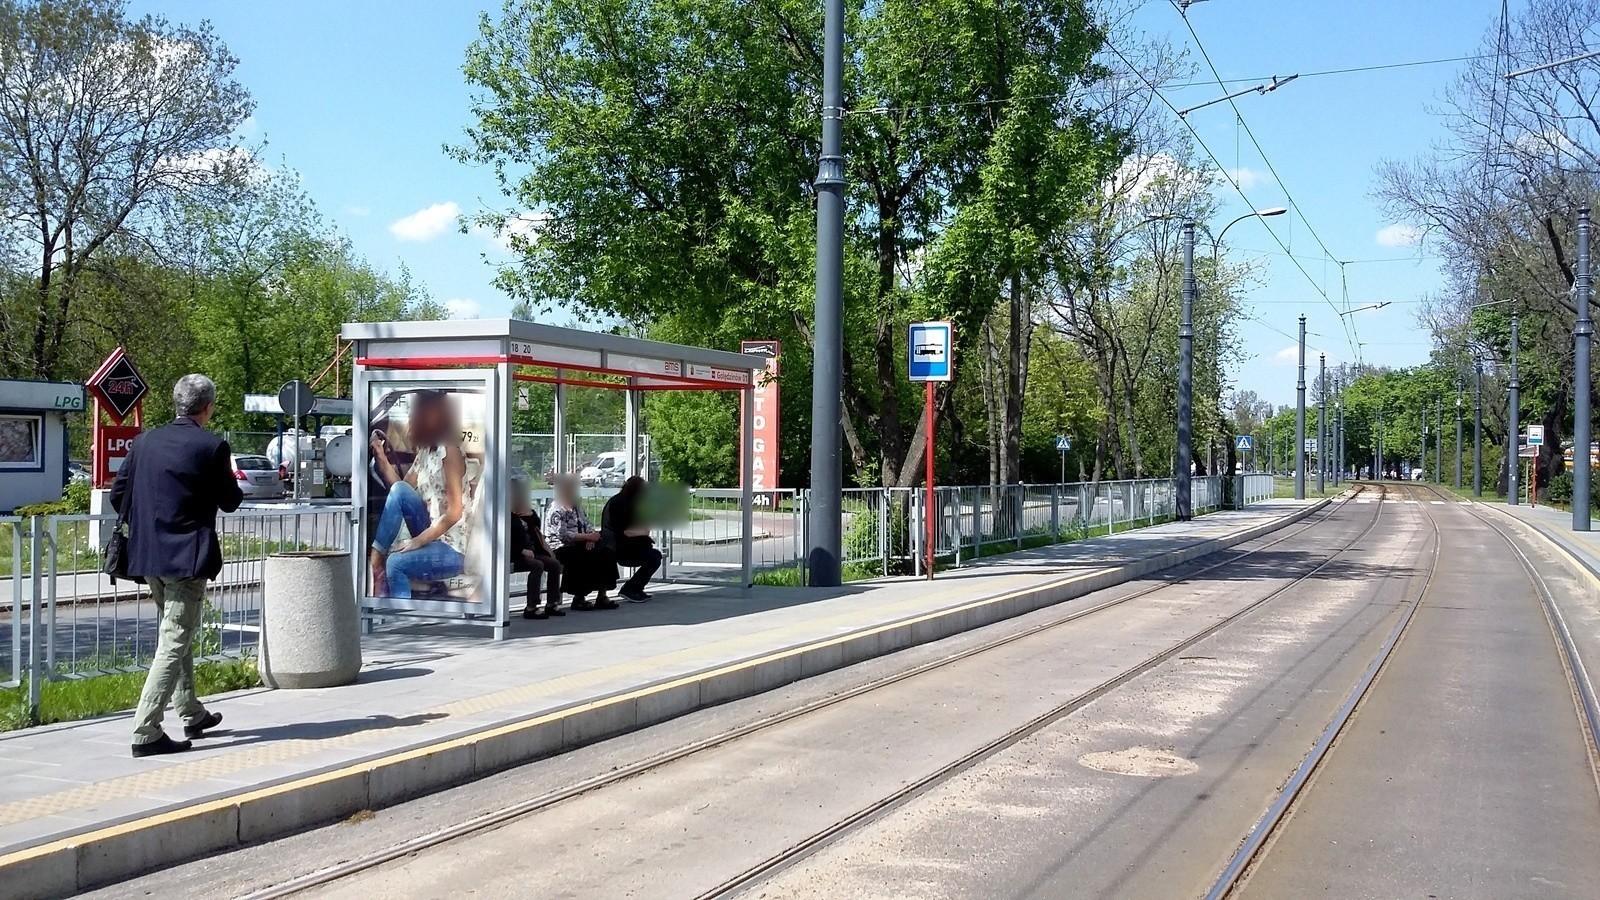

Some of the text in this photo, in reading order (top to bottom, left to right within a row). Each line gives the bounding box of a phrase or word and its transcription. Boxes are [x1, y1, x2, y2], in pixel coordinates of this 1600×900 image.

[511, 343, 531, 354] 18 20
[55, 396, 81, 408] LPG
[462, 431, 472, 442] 79
